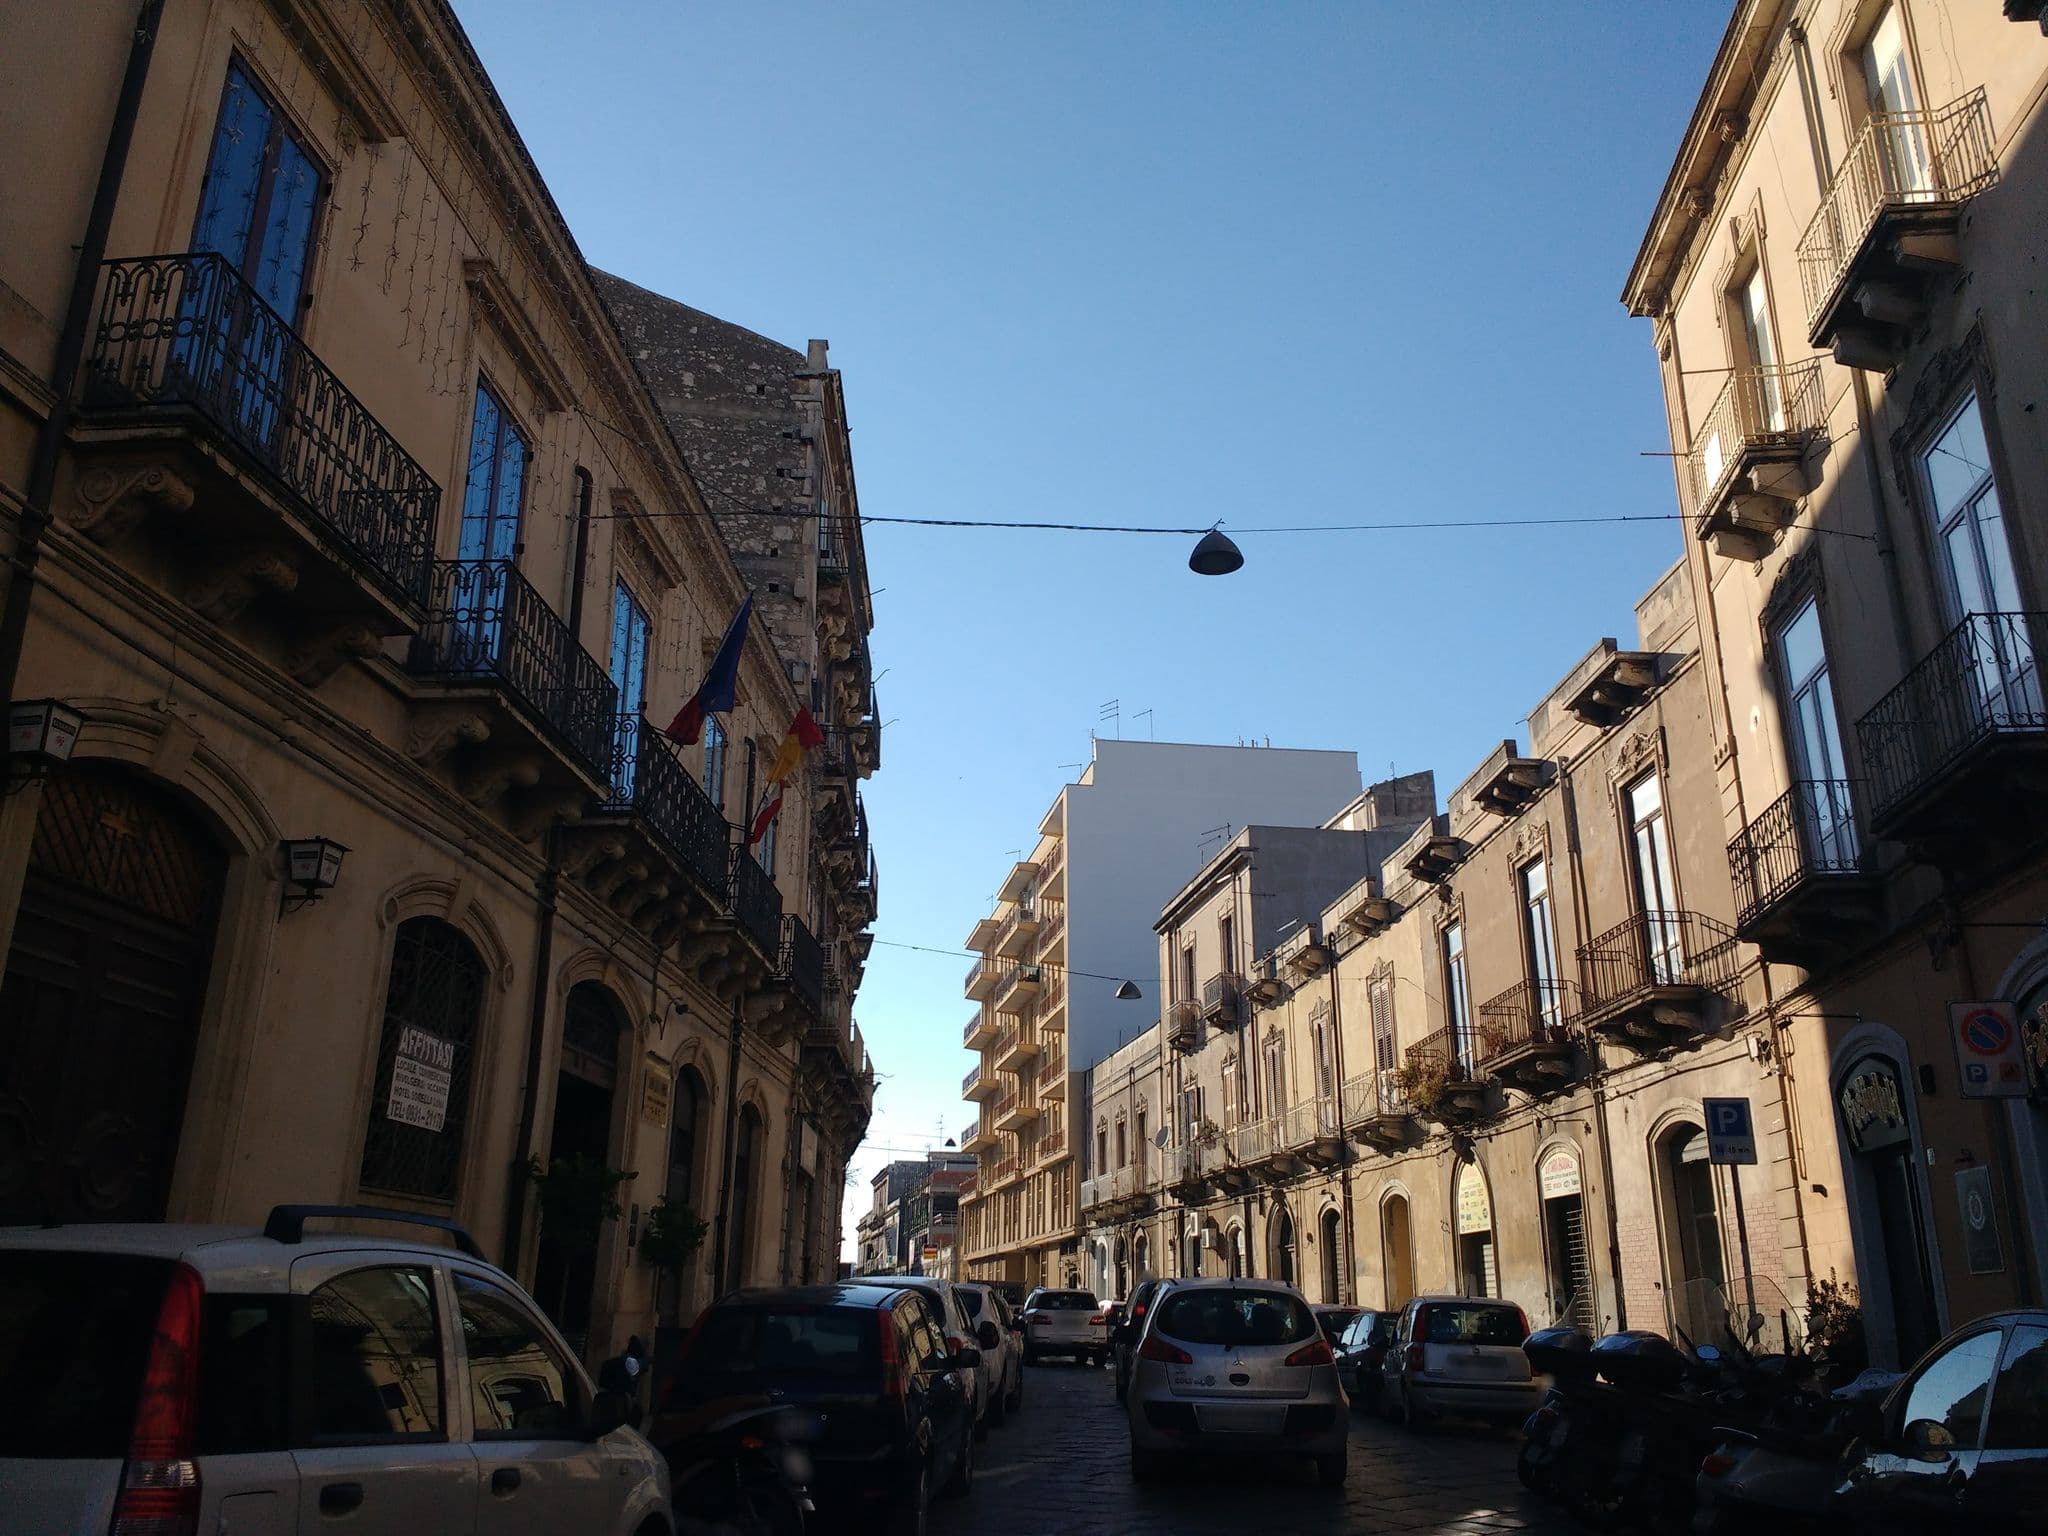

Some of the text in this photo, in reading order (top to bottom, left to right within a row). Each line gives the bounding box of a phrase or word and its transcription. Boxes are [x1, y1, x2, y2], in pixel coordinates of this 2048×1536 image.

[399, 1026, 454, 1070] AFFITTASI
[396, 1059, 417, 1074] LOCALE
[394, 1086, 410, 1099] HOTEL
[1718, 1106, 1738, 1132] P
